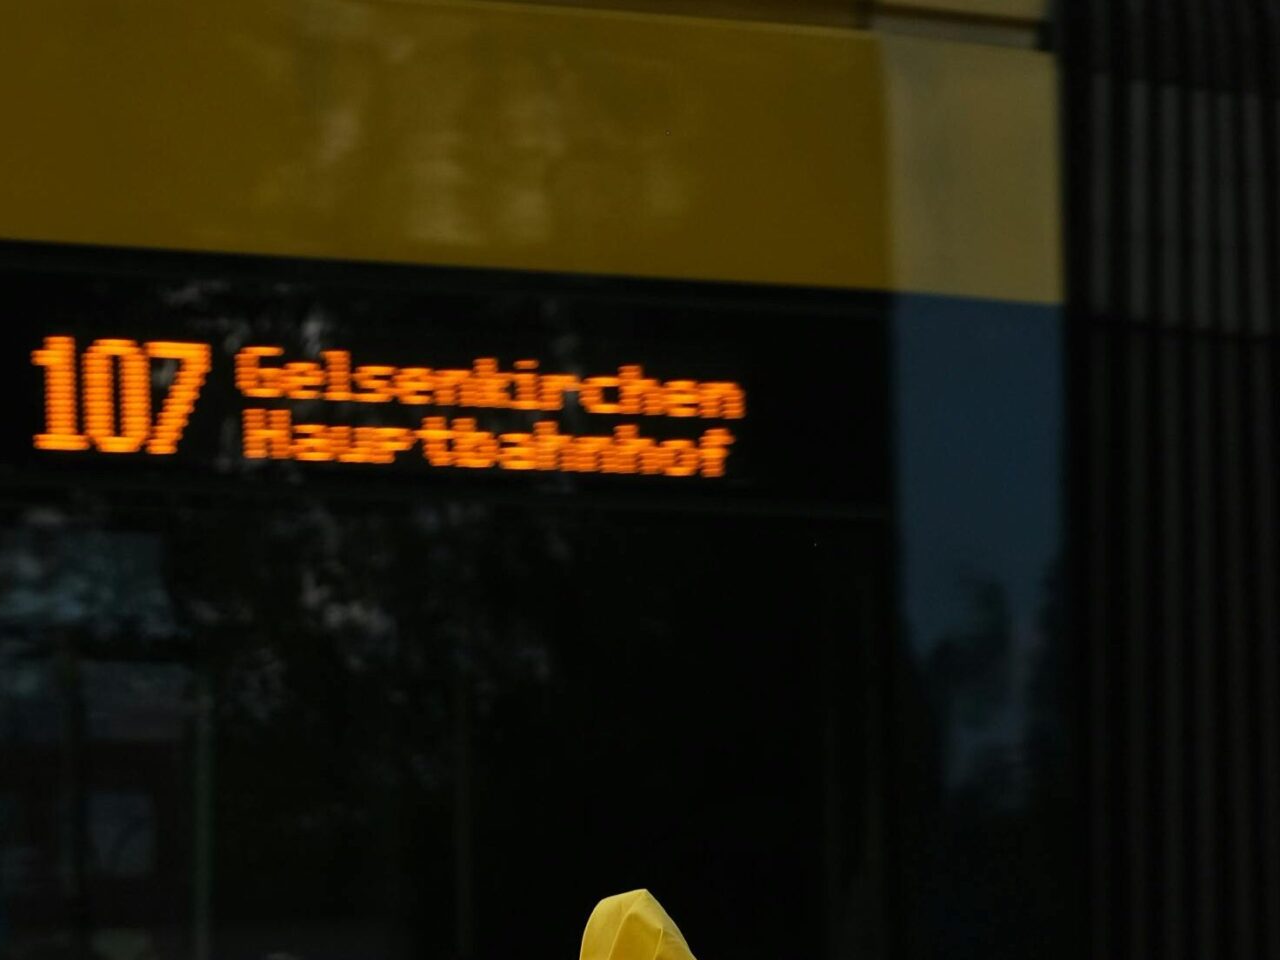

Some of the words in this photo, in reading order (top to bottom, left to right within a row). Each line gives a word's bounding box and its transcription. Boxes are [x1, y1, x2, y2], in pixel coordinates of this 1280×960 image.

[31, 335, 211, 454] 107
[234, 346, 746, 418] Gelsenkirchen
[242, 408, 735, 478] Hauptbahnhof
